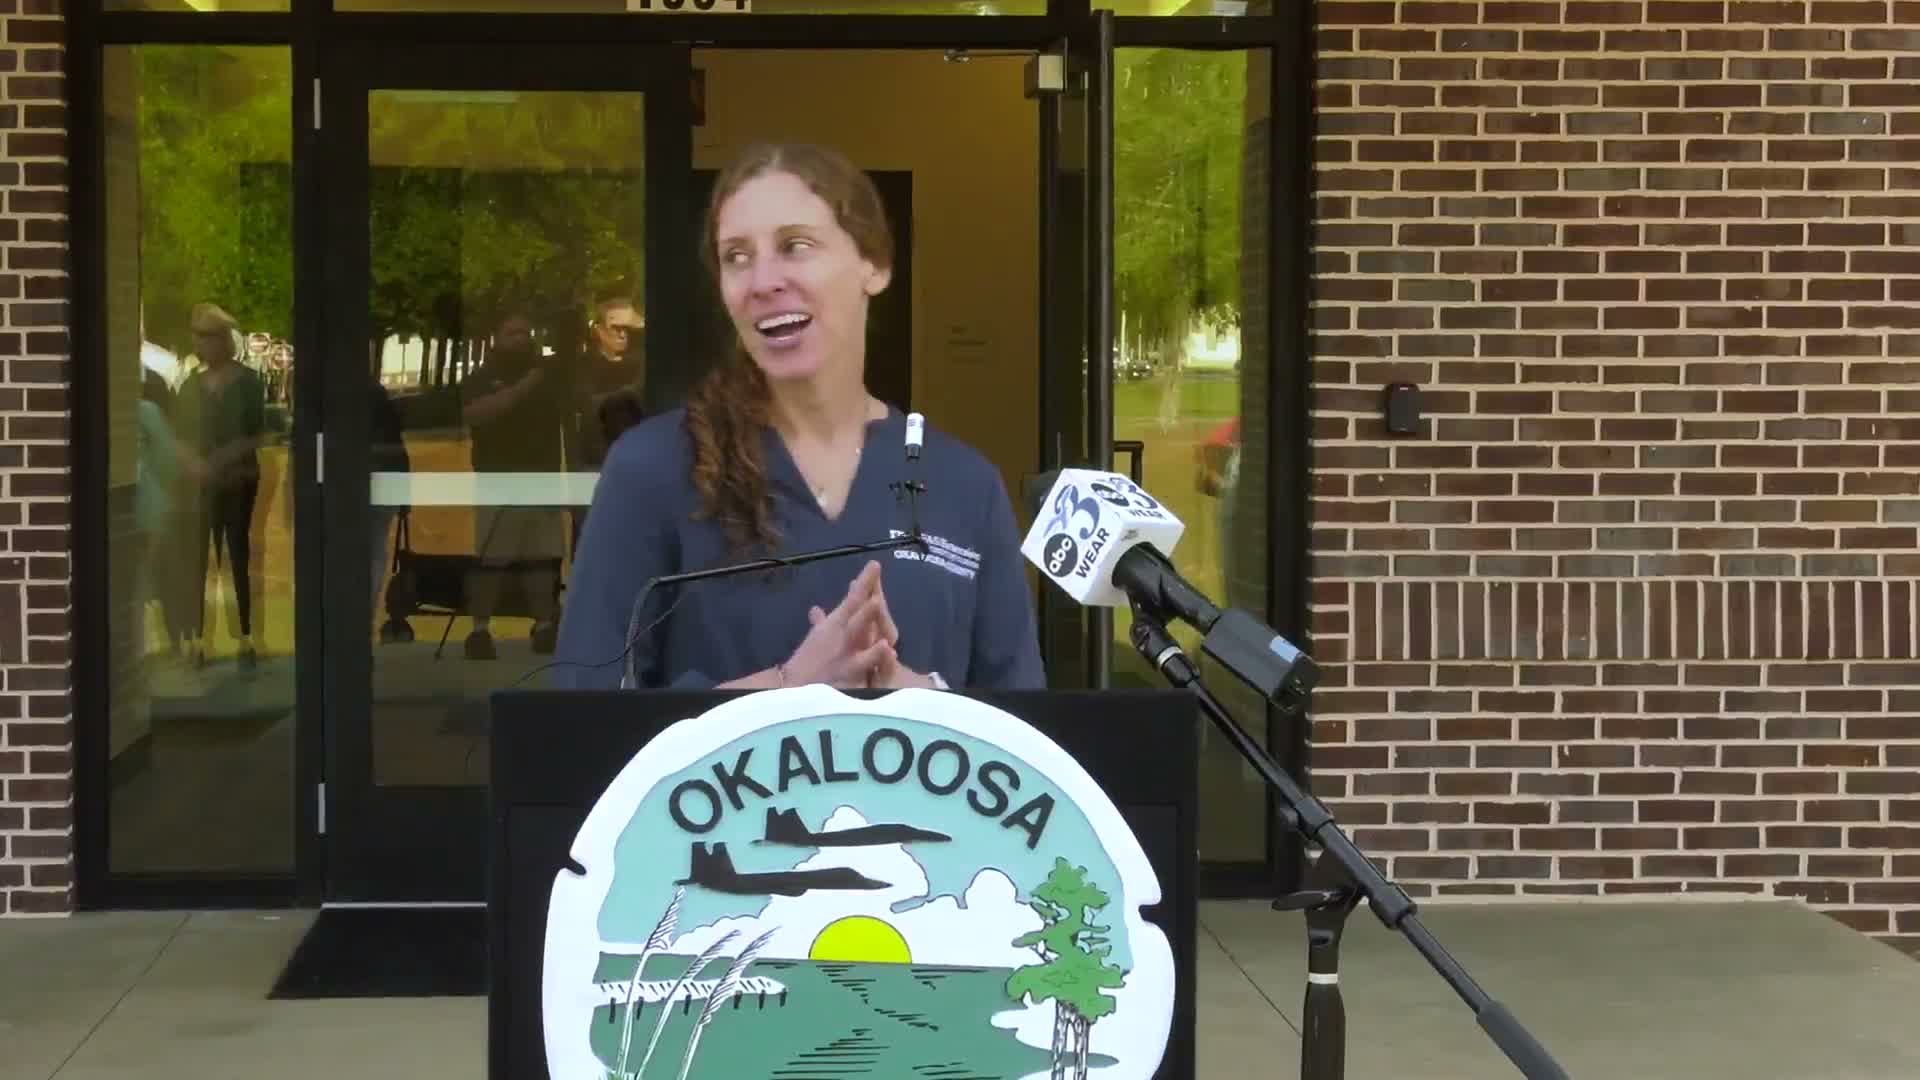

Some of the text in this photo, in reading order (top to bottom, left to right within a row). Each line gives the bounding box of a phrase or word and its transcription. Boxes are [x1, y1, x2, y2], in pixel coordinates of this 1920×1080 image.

[1049, 538, 1073, 574] abc
[1075, 527, 1110, 578] WEAR
[668, 727, 1056, 850] OKALOOSA
